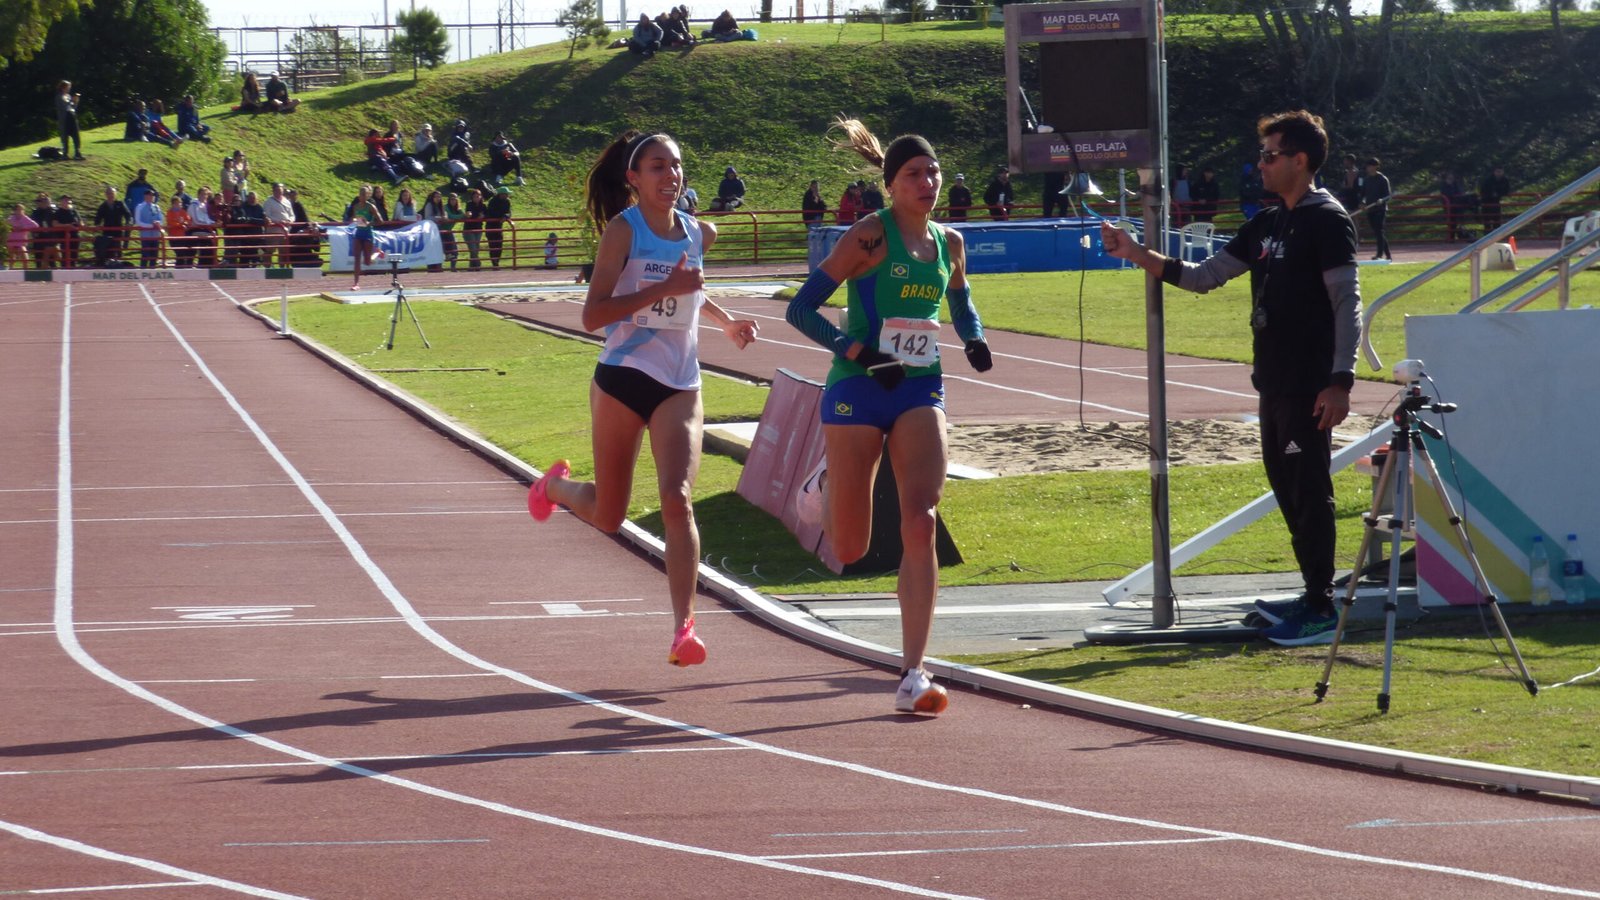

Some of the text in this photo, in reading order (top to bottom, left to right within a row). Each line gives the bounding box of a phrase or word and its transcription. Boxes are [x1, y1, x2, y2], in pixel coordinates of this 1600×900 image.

[1042, 13, 1120, 24] MAR DEL PLATA
[1075, 144, 1094, 152] DEL
[1096, 142, 1127, 152] PLATA
[644, 263, 674, 275] ARGE
[92, 271, 174, 280] MAR DEL PLATA
[900, 284, 940, 301] BRASIL
[651, 296, 677, 317] 49
[891, 332, 928, 356] 142
